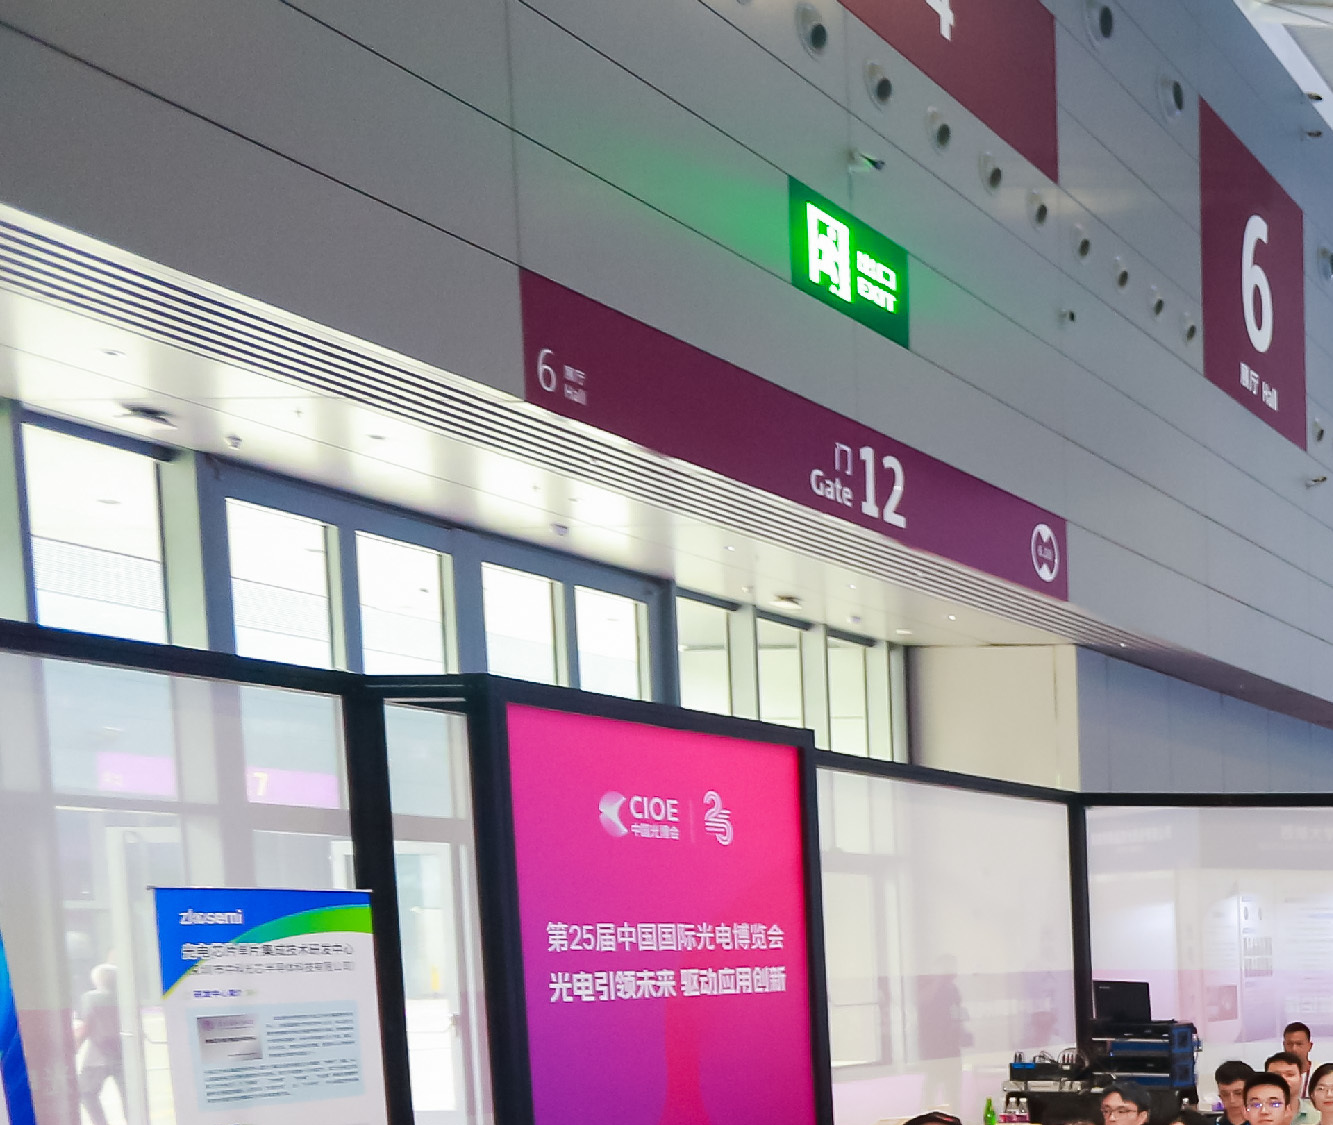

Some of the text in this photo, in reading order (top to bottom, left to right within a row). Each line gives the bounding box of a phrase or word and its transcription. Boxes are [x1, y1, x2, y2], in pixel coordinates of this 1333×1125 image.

[857, 281, 898, 314] EXIT
[1242, 215, 1273, 353] 6
[536, 349, 556, 392] 6
[810, 468, 853, 508] Gate
[859, 446, 907, 529] 12
[629, 796, 680, 822] CIOE
[547, 921, 785, 952] 第25届中国国际光电博览会
[548, 966, 786, 1003] 光电引领未来 驱动应用创新
